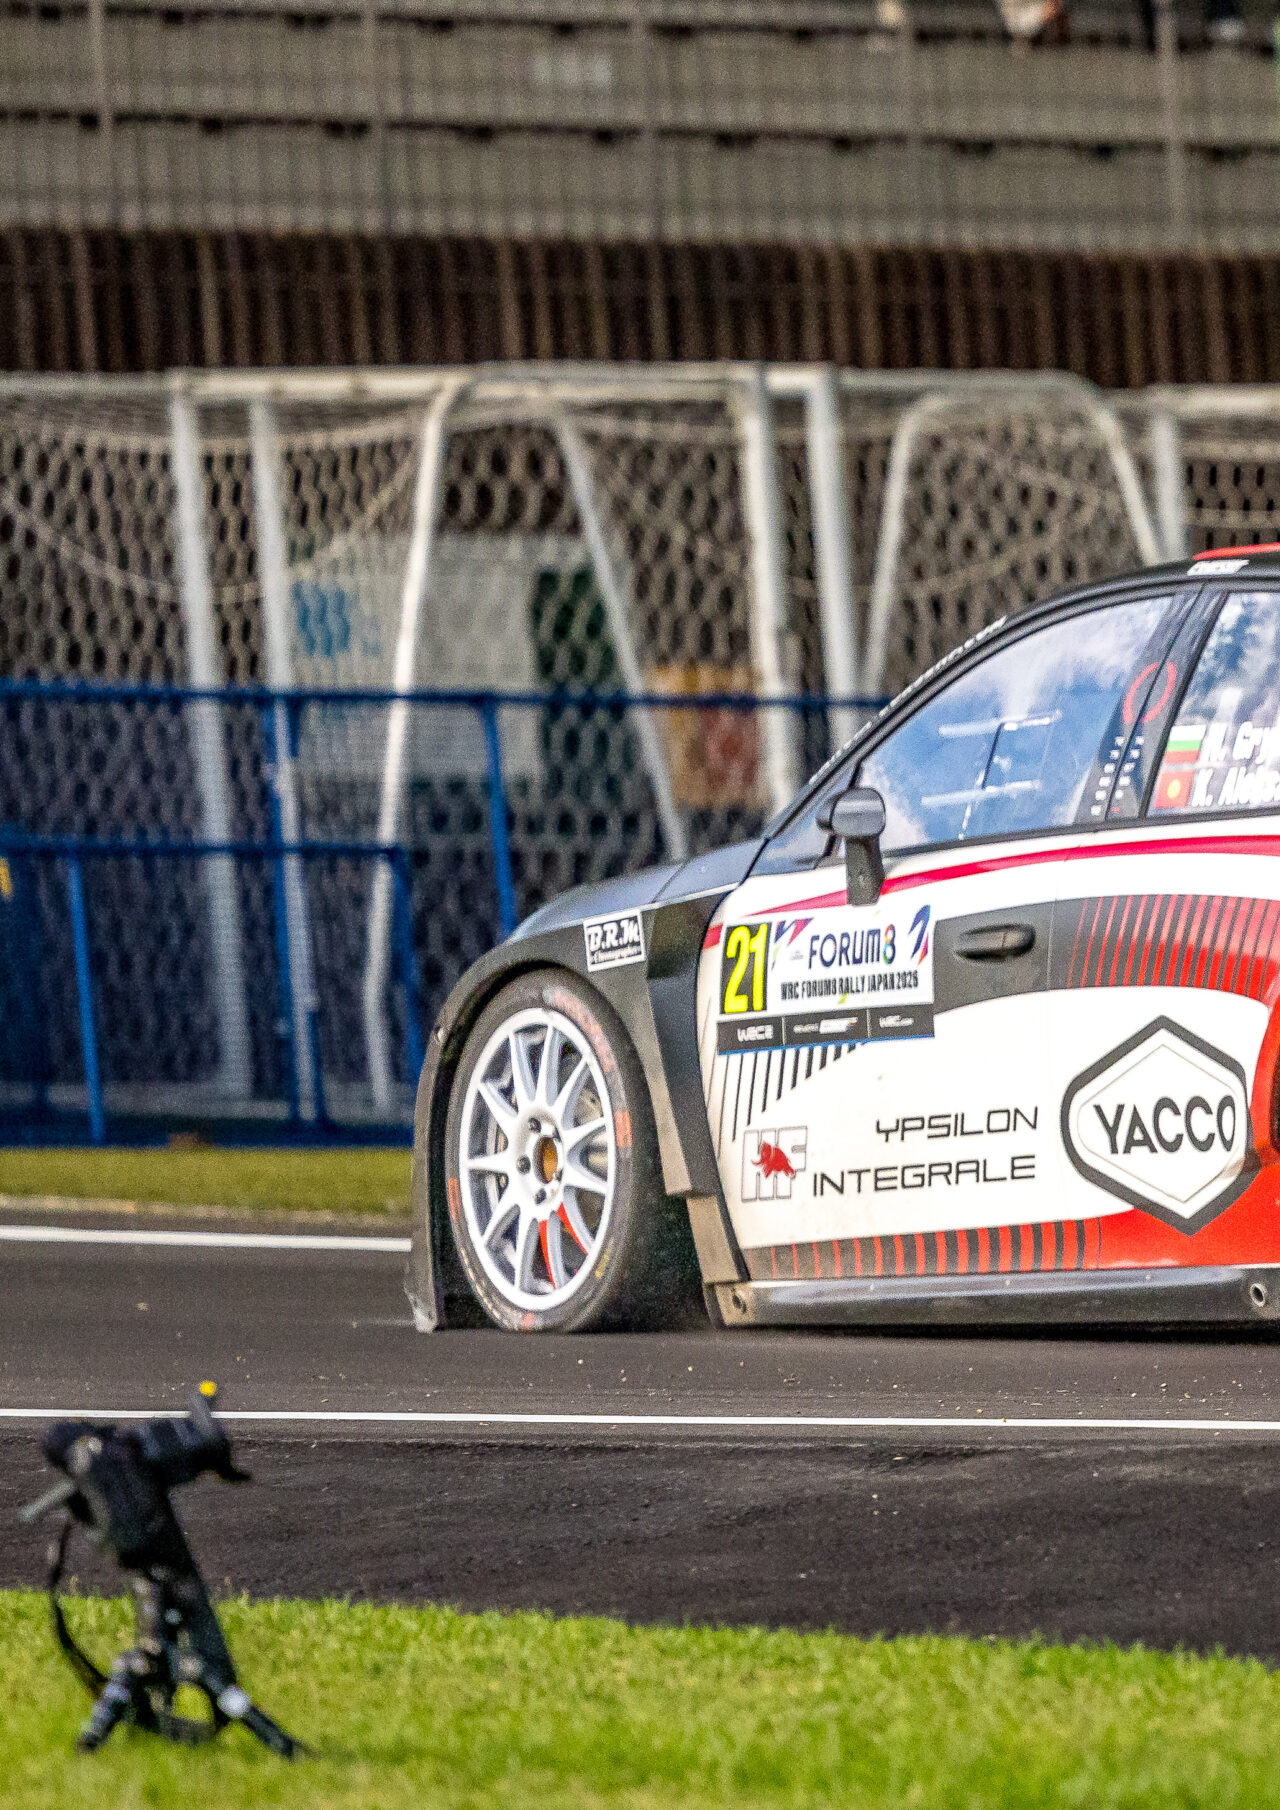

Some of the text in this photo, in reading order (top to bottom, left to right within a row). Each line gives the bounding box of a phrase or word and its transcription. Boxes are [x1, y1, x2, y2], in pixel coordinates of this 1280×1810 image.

[724, 923, 769, 1014] 21
[808, 923, 896, 970] FORUM8
[780, 980, 800, 1001] WRC
[801, 977, 837, 998] FORUM8
[839, 974, 866, 996] RALLY
[867, 971, 895, 993] JAPAN
[876, 1106, 1039, 1143] YPSILON
[1094, 1095, 1237, 1155] YACCO
[813, 1154, 1037, 1198] INTEGRALE
